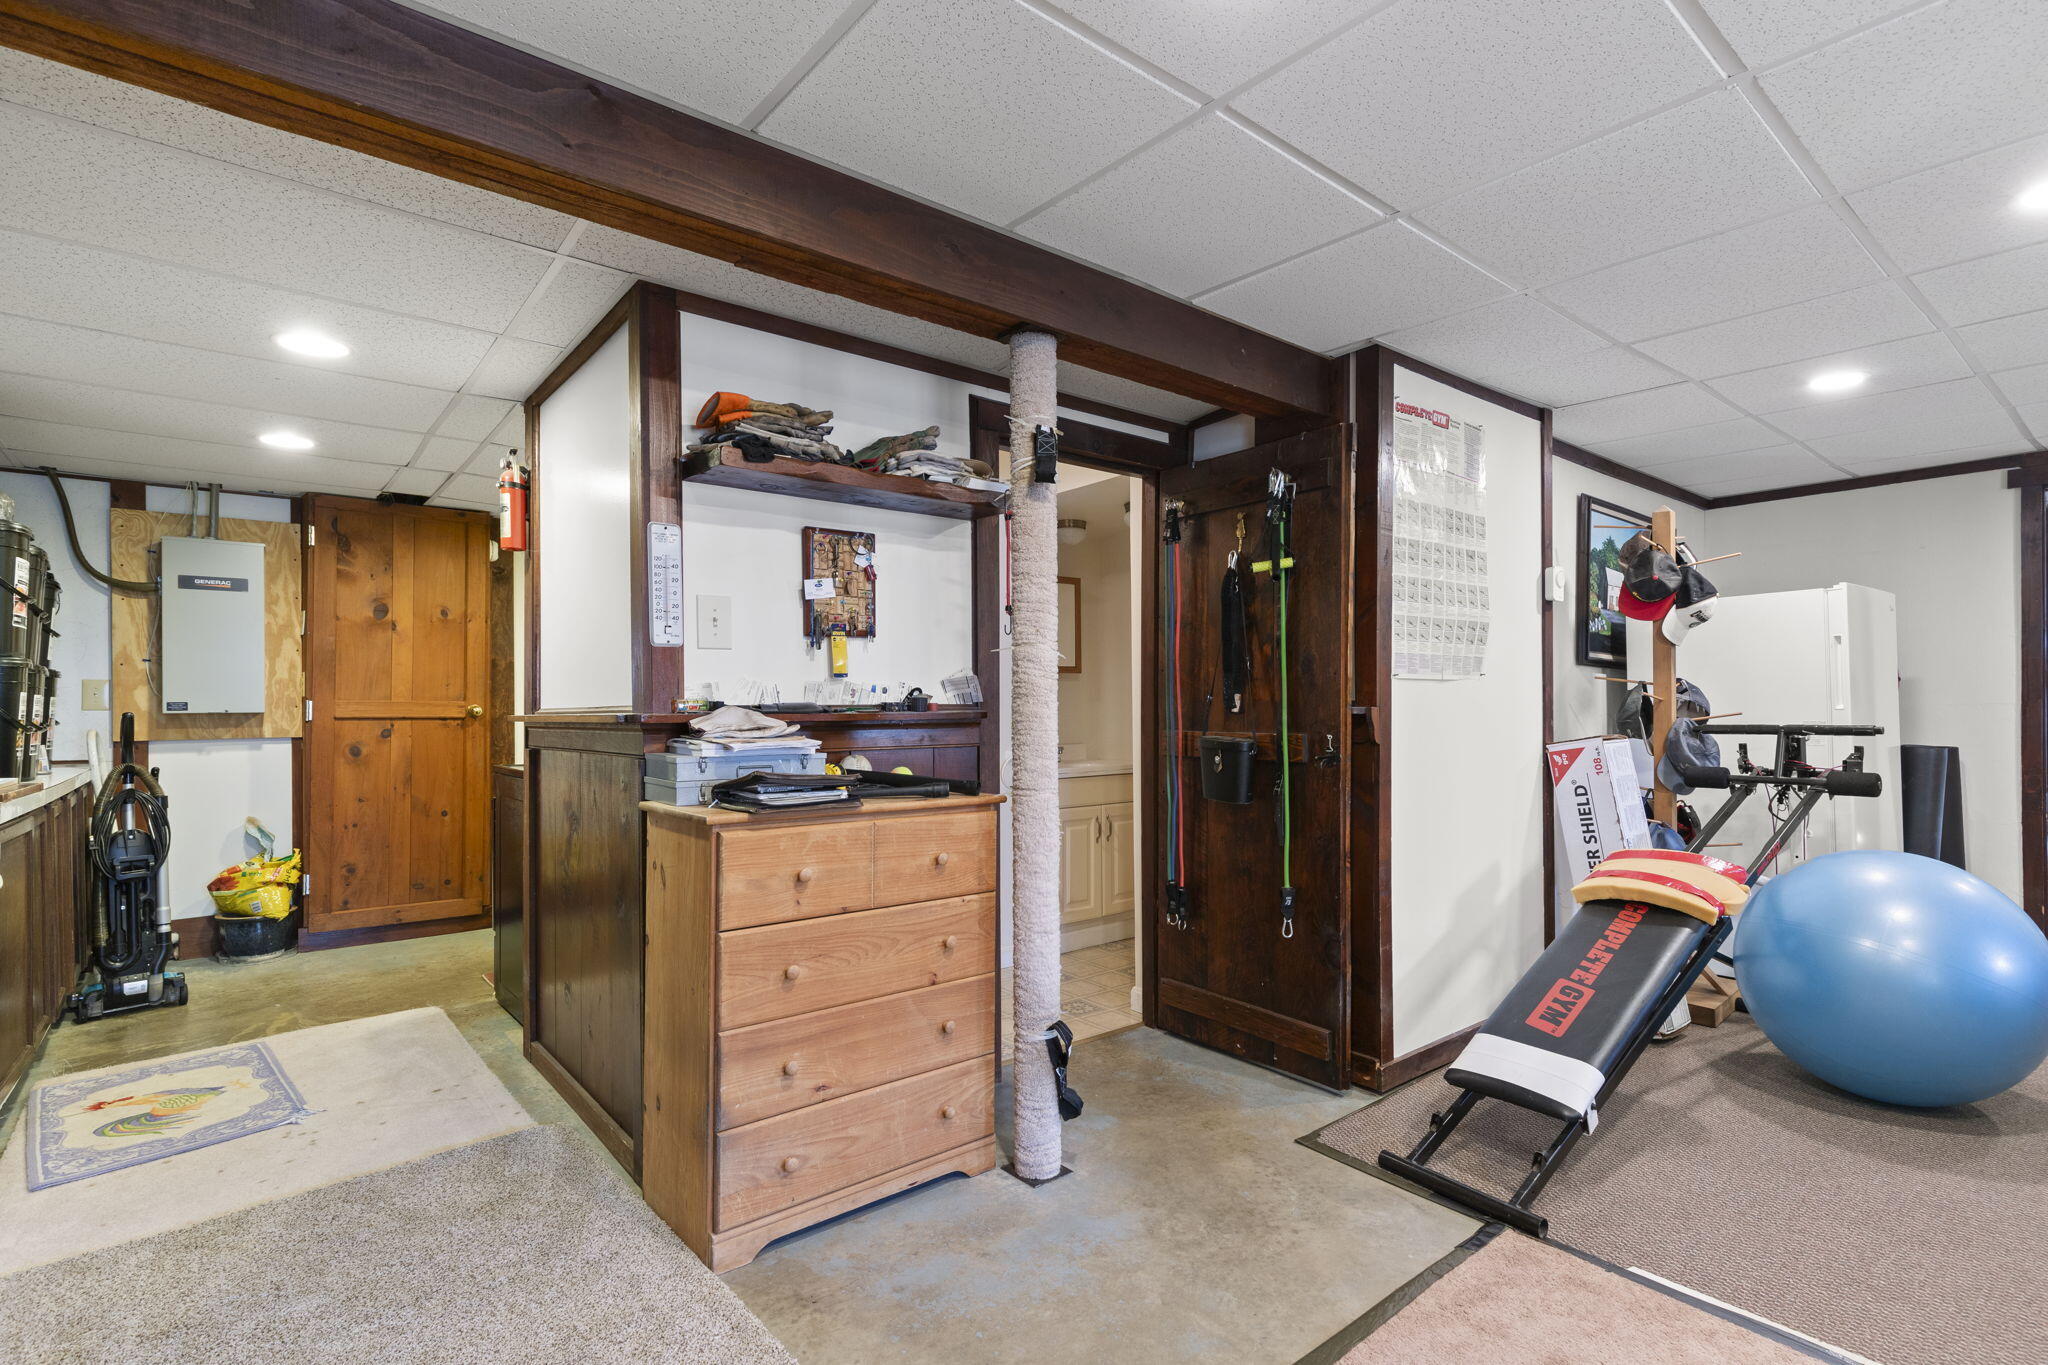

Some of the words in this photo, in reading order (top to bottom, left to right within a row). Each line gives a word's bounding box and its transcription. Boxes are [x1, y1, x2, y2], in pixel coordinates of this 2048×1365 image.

[1593, 757, 1603, 776] 108
[1570, 903, 1649, 985] COMPLETE
[1539, 985, 1584, 1026] GYM
